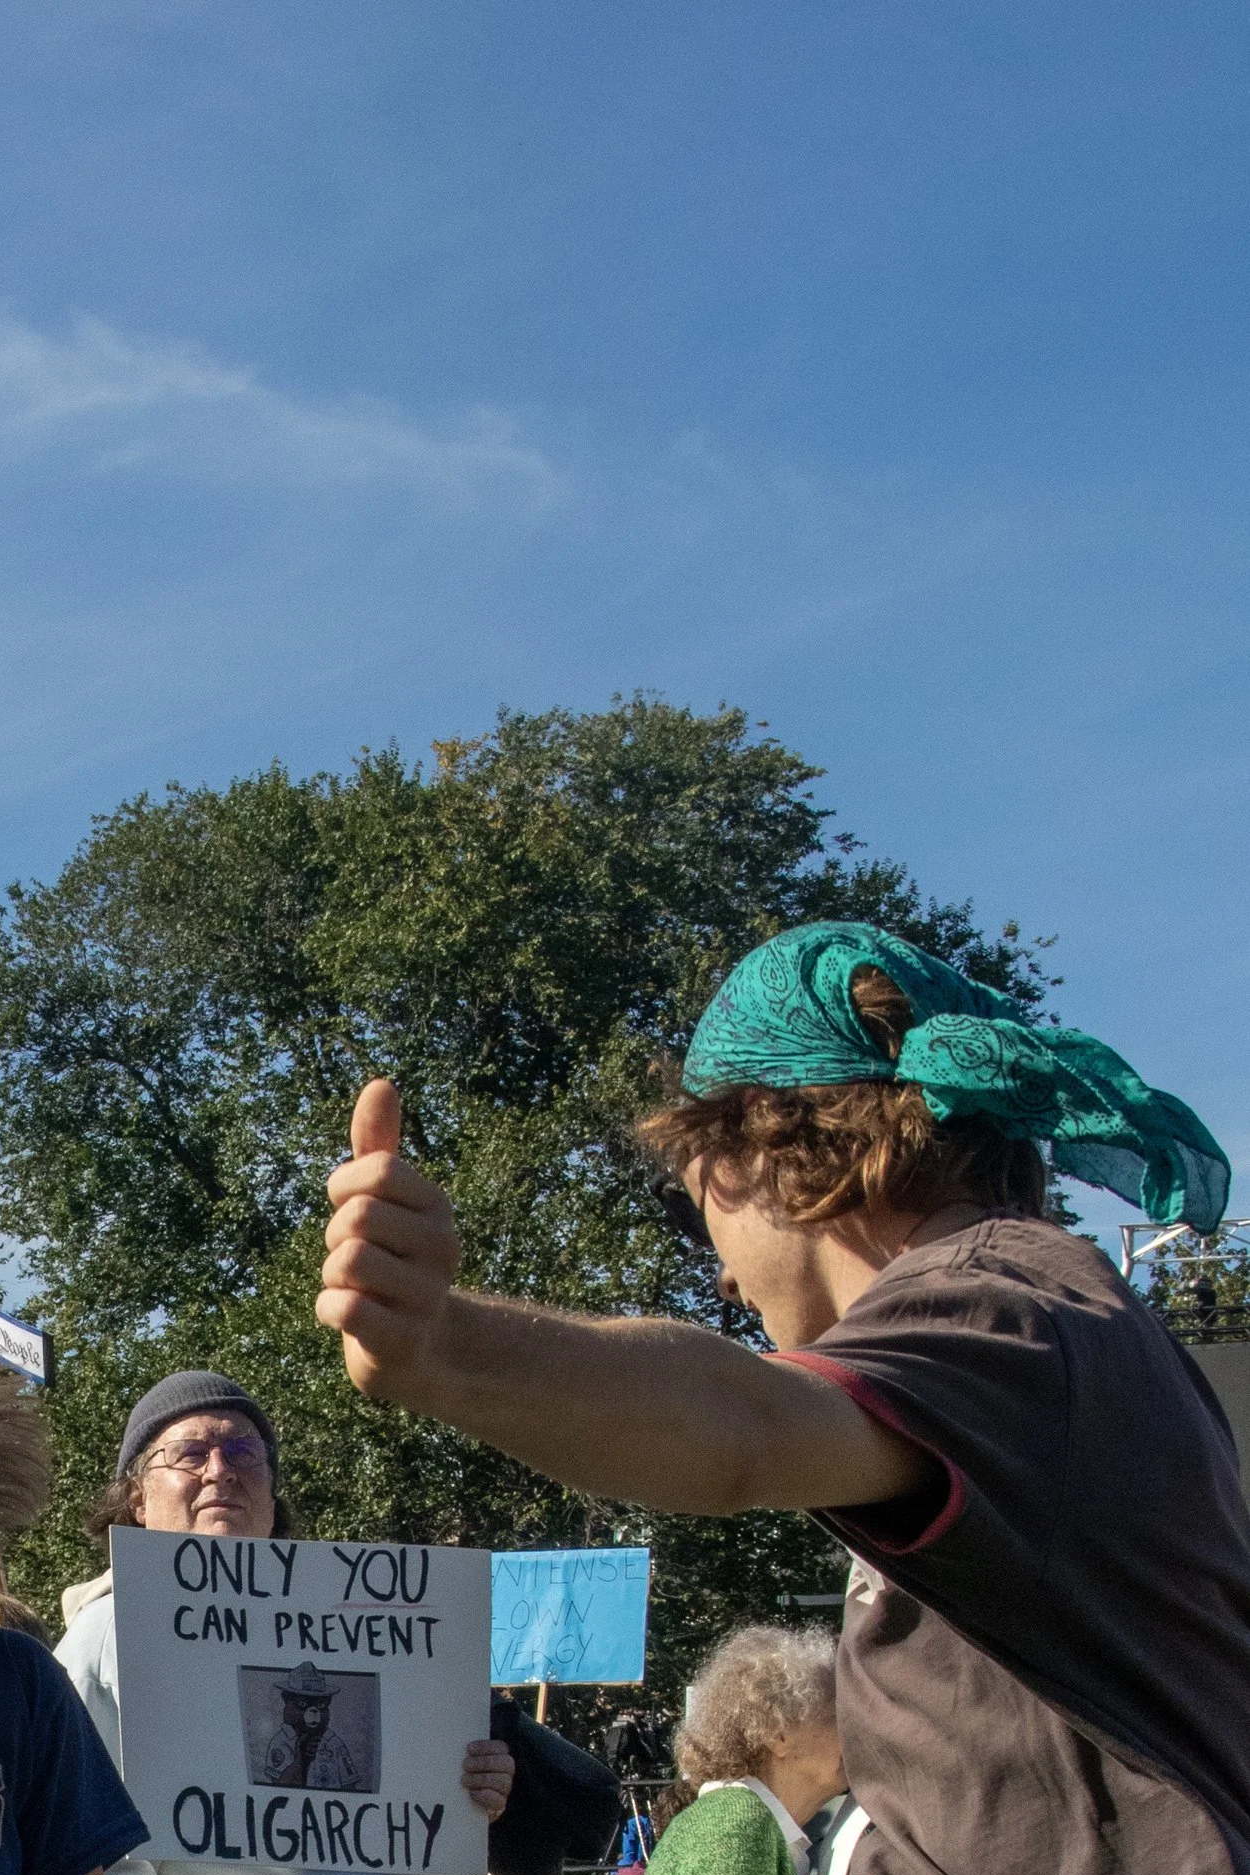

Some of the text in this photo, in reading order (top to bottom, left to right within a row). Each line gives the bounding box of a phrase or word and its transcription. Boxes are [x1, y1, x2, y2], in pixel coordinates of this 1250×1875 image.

[173, 1538, 430, 1604] ONLY YOU
[491, 1551, 647, 1588] NTENSE
[173, 1605, 441, 1659] CAN PREVENT
[173, 1786, 444, 1871] OLIGARCHY
